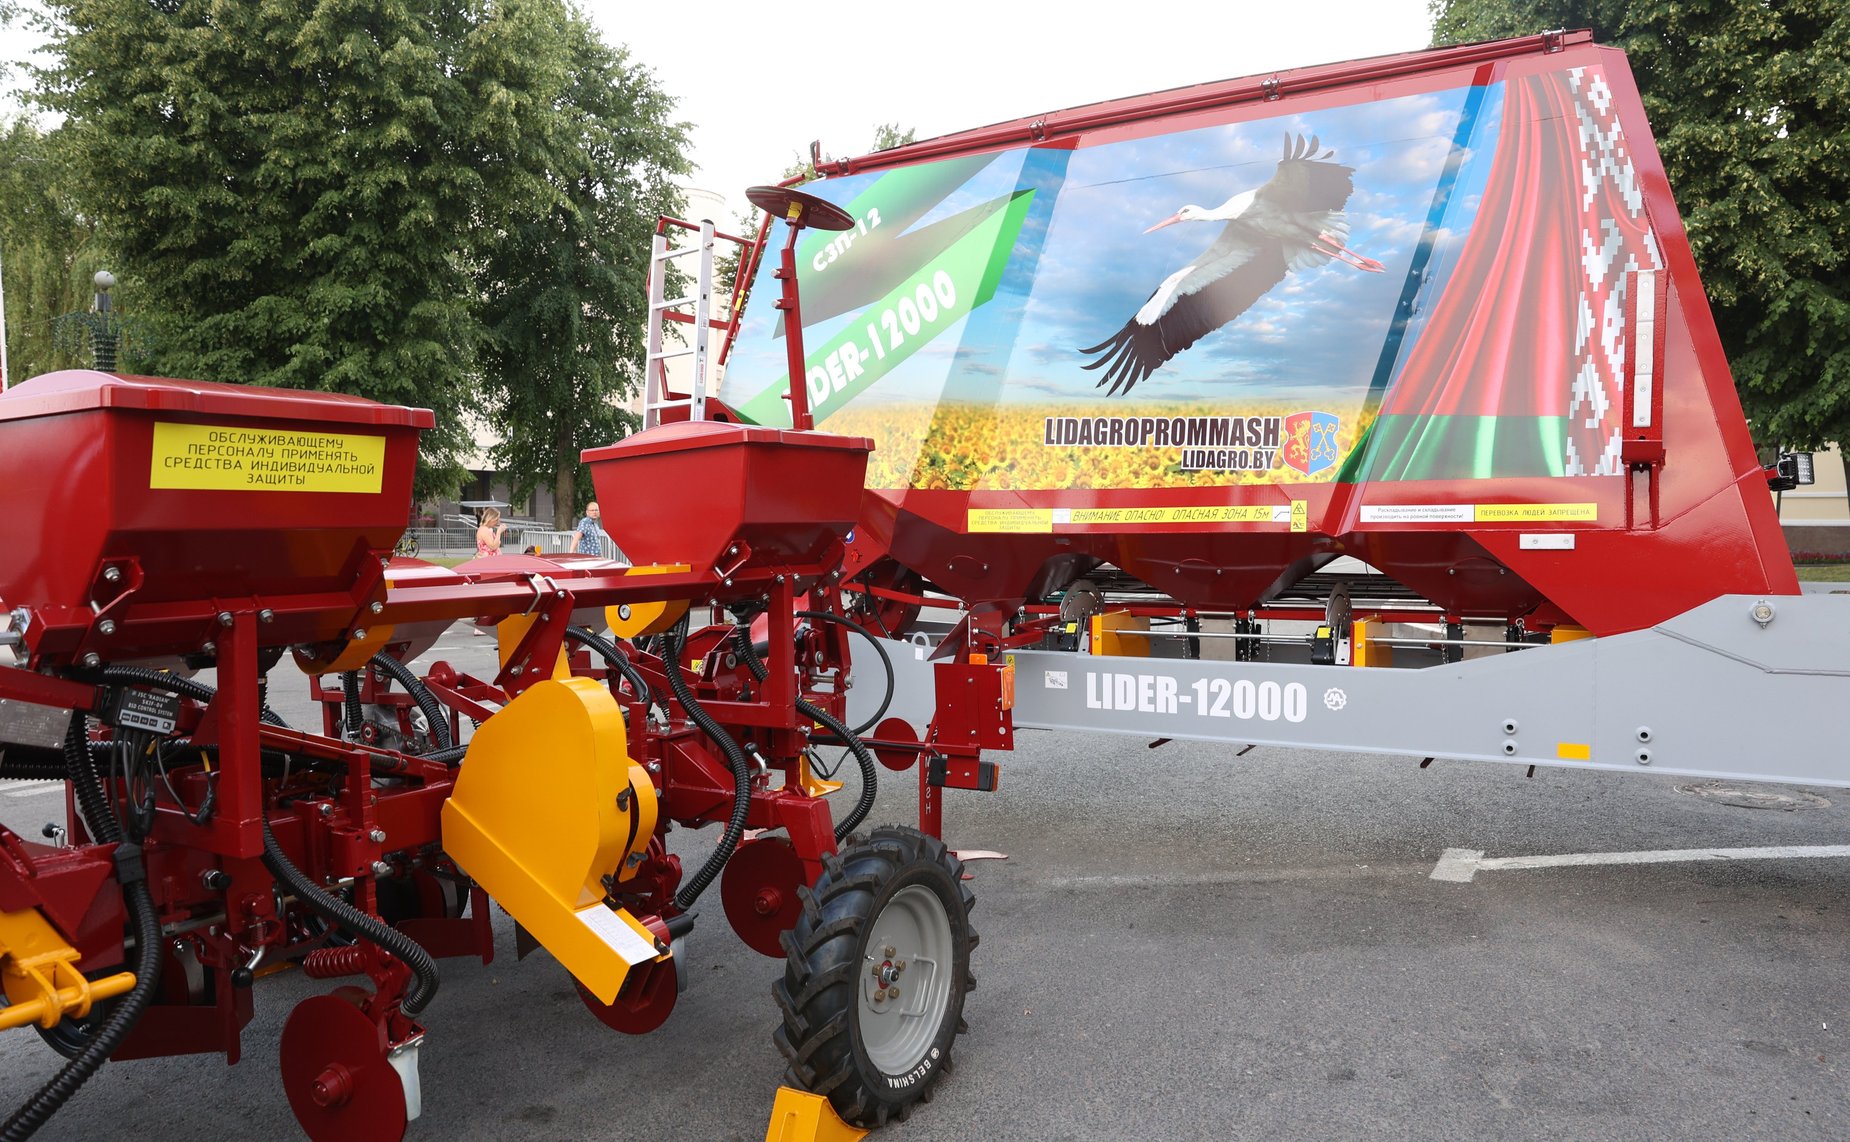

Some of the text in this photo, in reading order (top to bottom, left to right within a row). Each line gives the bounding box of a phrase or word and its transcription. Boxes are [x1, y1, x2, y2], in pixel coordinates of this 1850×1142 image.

[812, 207, 882, 272] СЗП-12
[208, 431, 344, 449] ОБСЛУЖИВАЮЩЕМУ
[1045, 417, 1281, 448] LIDAGROPROMMASH
[188, 443, 359, 462] ПЕРСОНАЛУ ПРИМЕНЯТЬ
[1182, 450, 1275, 470] LIDAGRO.BY
[164, 456, 375, 475] СРЕДСТВА ИНДИВИДУАЛЬНОЙ
[246, 473, 306, 486] ЗАЩИТЫ
[1073, 510, 1123, 522] ВНИМАНИЕ
[1172, 508, 1219, 520] ОПАСНАЯ
[1221, 508, 1248, 520] ЗОНА
[1480, 509, 1519, 517] ПЕРЕВОЗКА
[1549, 508, 1591, 516] ЗАПРЕЩЕНА
[1086, 671, 1308, 723] LIDER-12000
[137, 704, 157, 714] CONTROL
[157, 709, 174, 718] SYSTEM
[887, 1059, 932, 1089] BELSHINA
